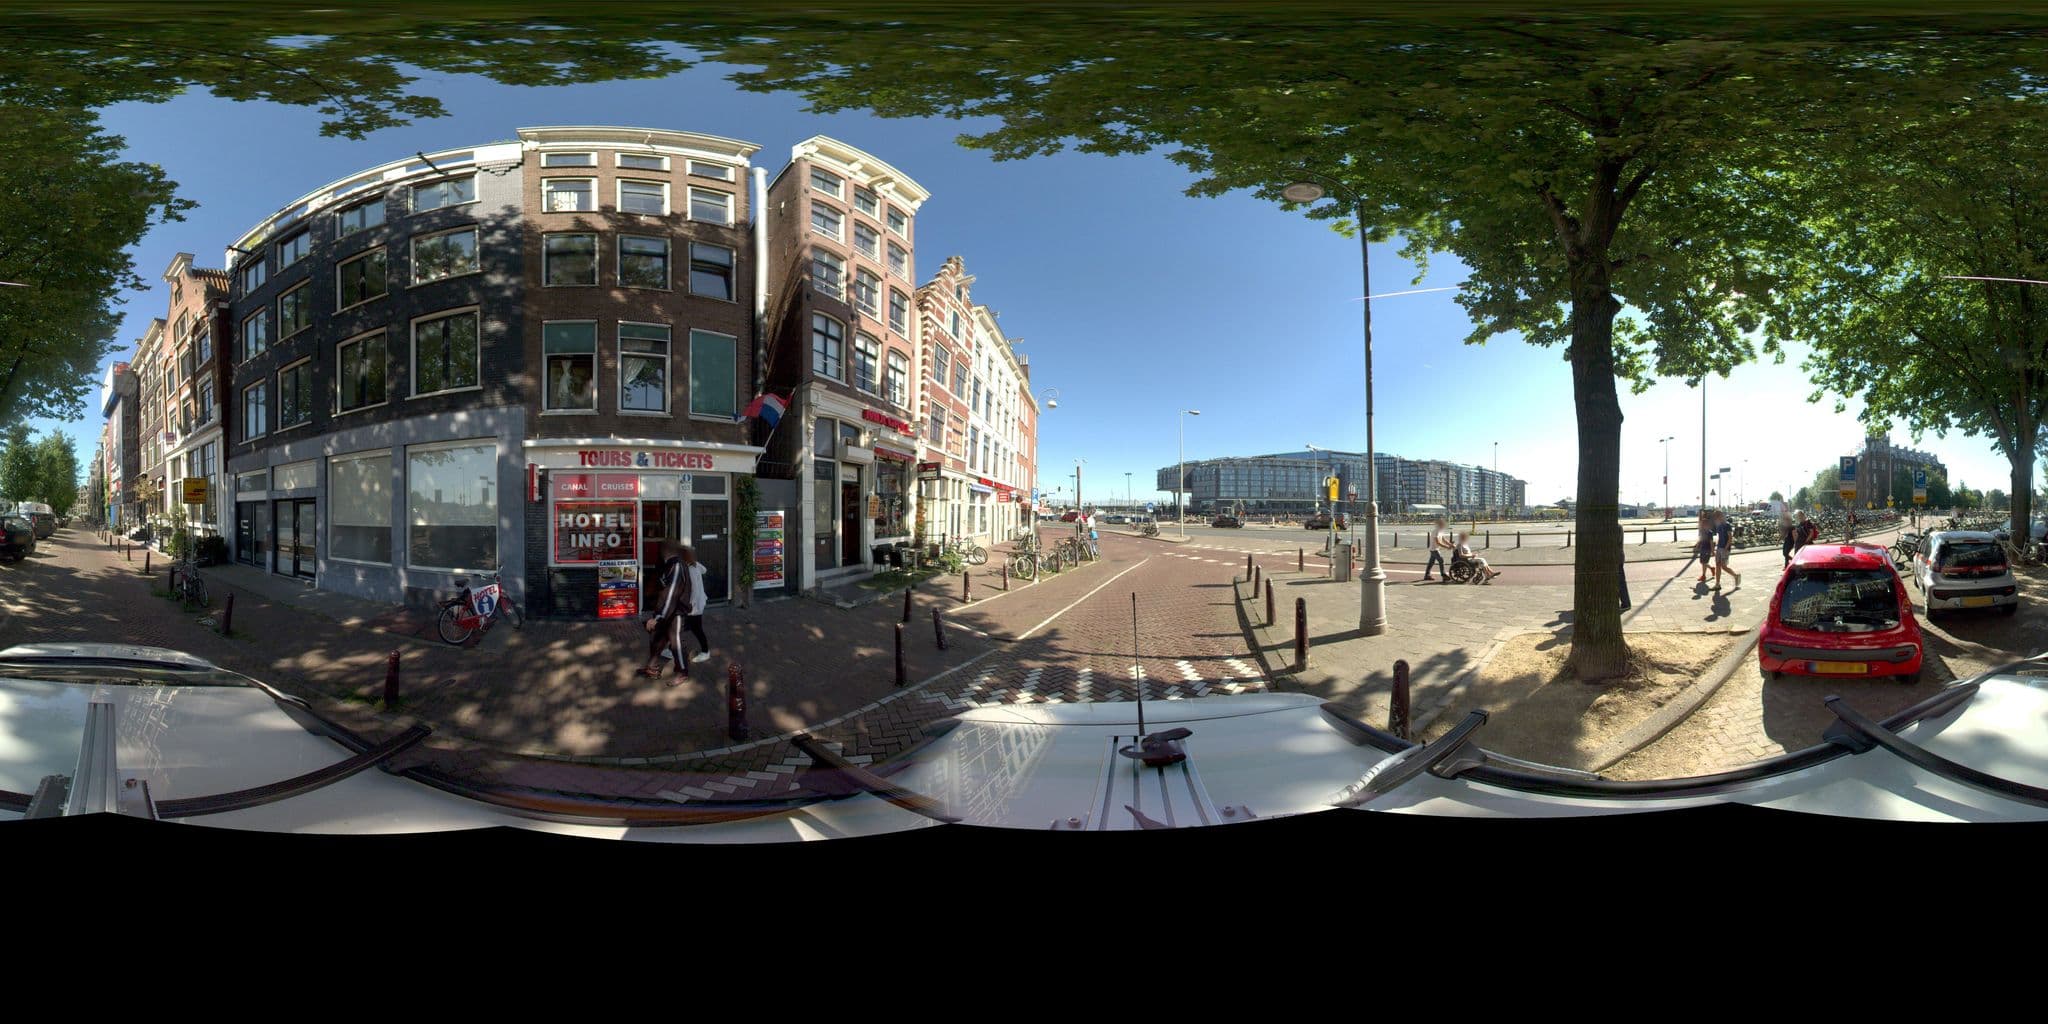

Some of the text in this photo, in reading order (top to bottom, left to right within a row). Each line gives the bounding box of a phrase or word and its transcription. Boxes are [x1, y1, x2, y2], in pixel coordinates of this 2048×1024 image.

[578, 450, 714, 470] TOURS & TICKETS
[1844, 458, 1853, 471] P
[1916, 471, 1924, 482] P
[561, 482, 634, 491] CANAL CRUISES
[559, 513, 632, 528] HOTEL
[570, 533, 622, 548] INFO
[473, 585, 498, 602] HOTEL
